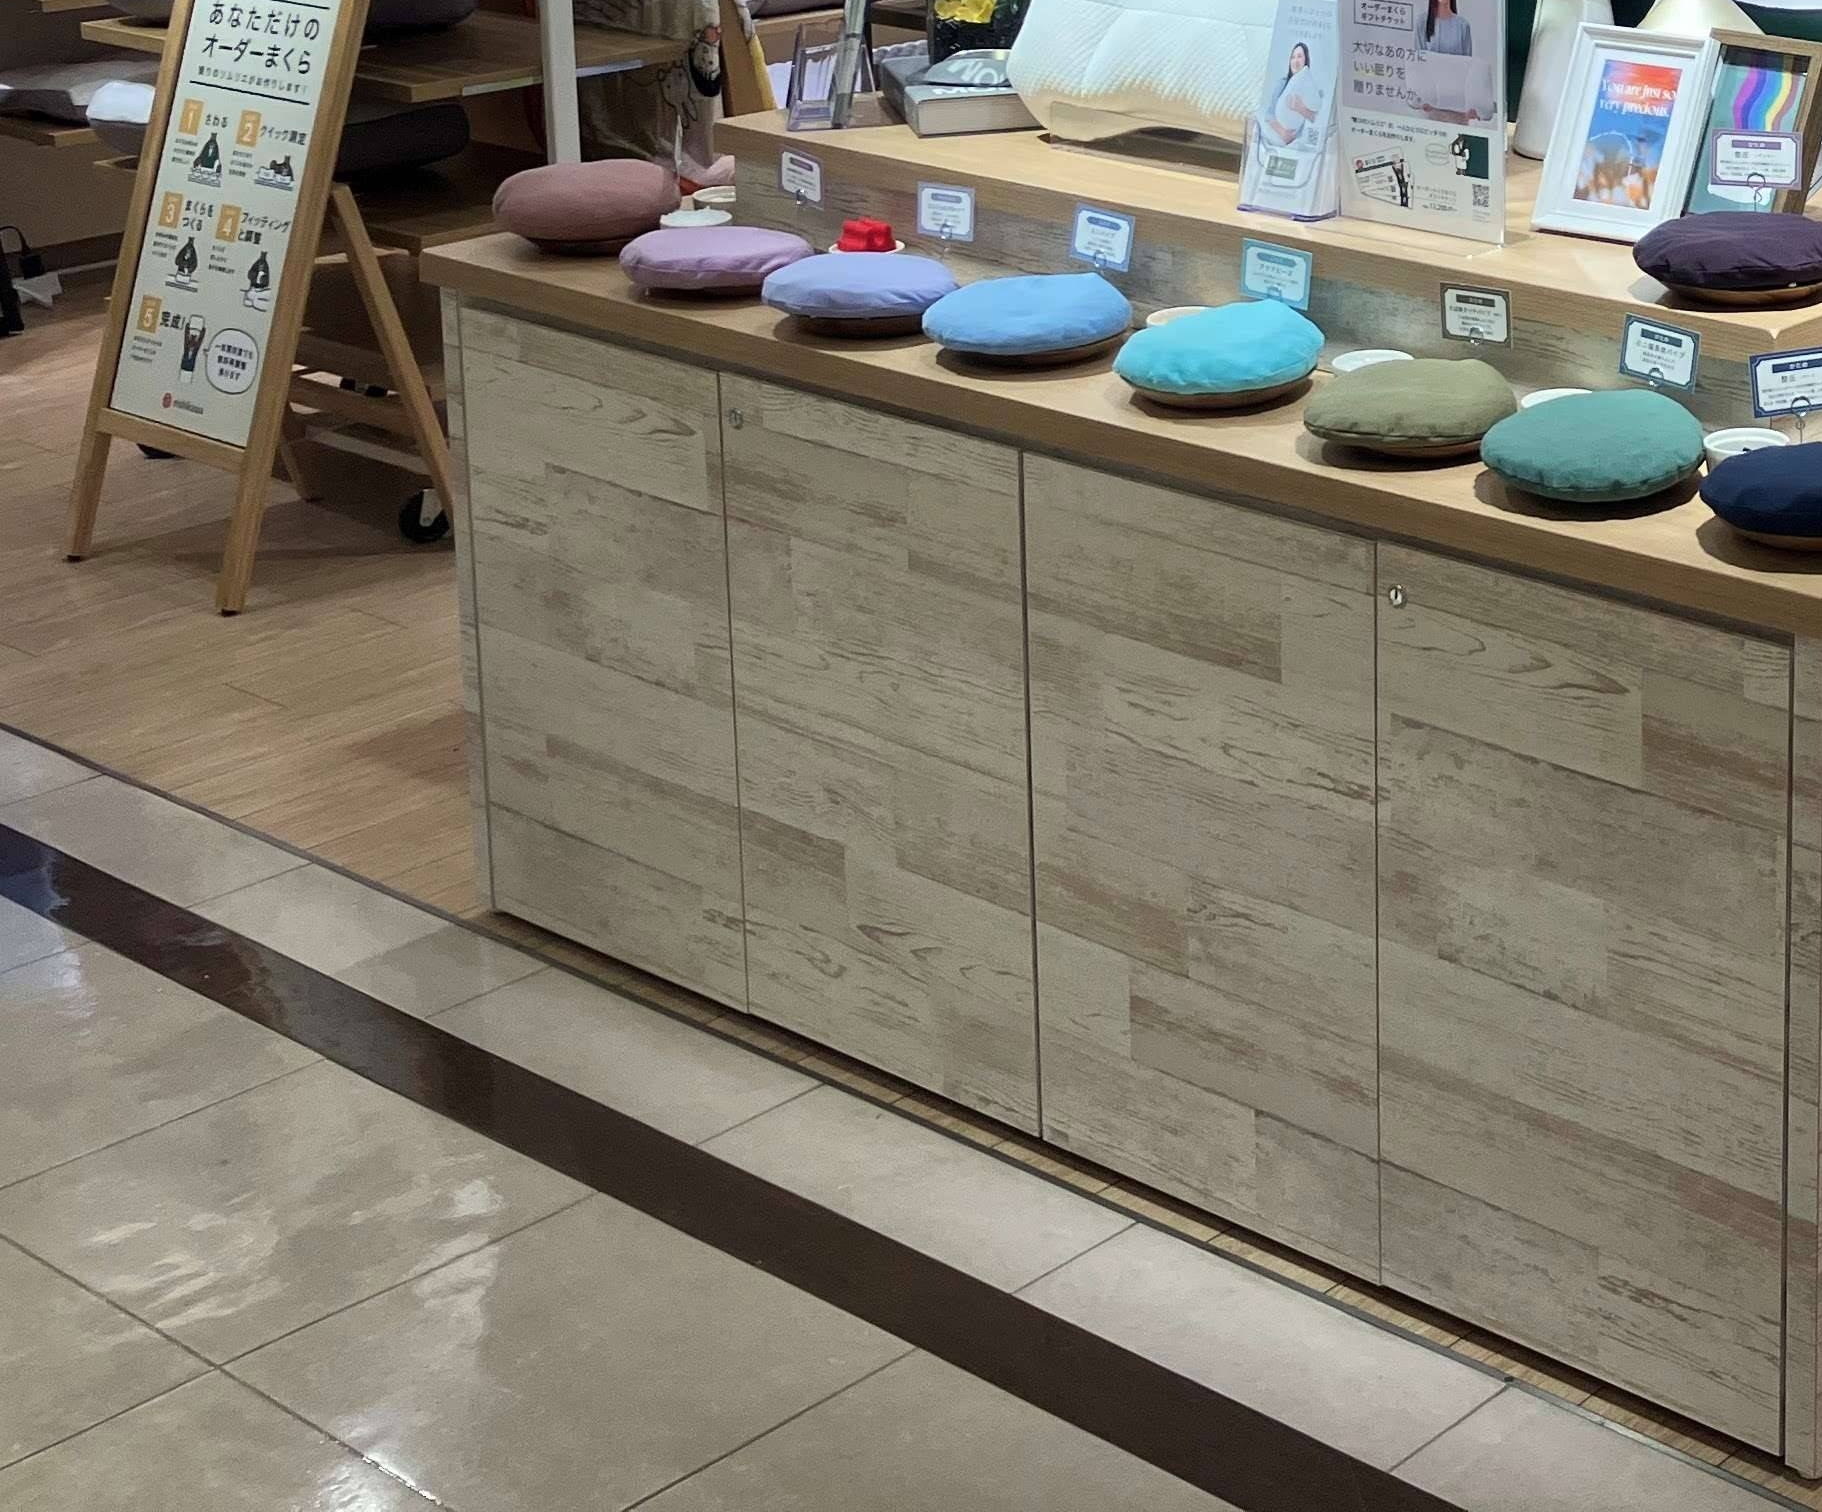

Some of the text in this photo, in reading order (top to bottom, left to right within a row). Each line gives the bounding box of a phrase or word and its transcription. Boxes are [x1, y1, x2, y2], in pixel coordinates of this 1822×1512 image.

[210, 0, 320, 40] あなただけの
[202, 36, 311, 74] オーダーまくら
